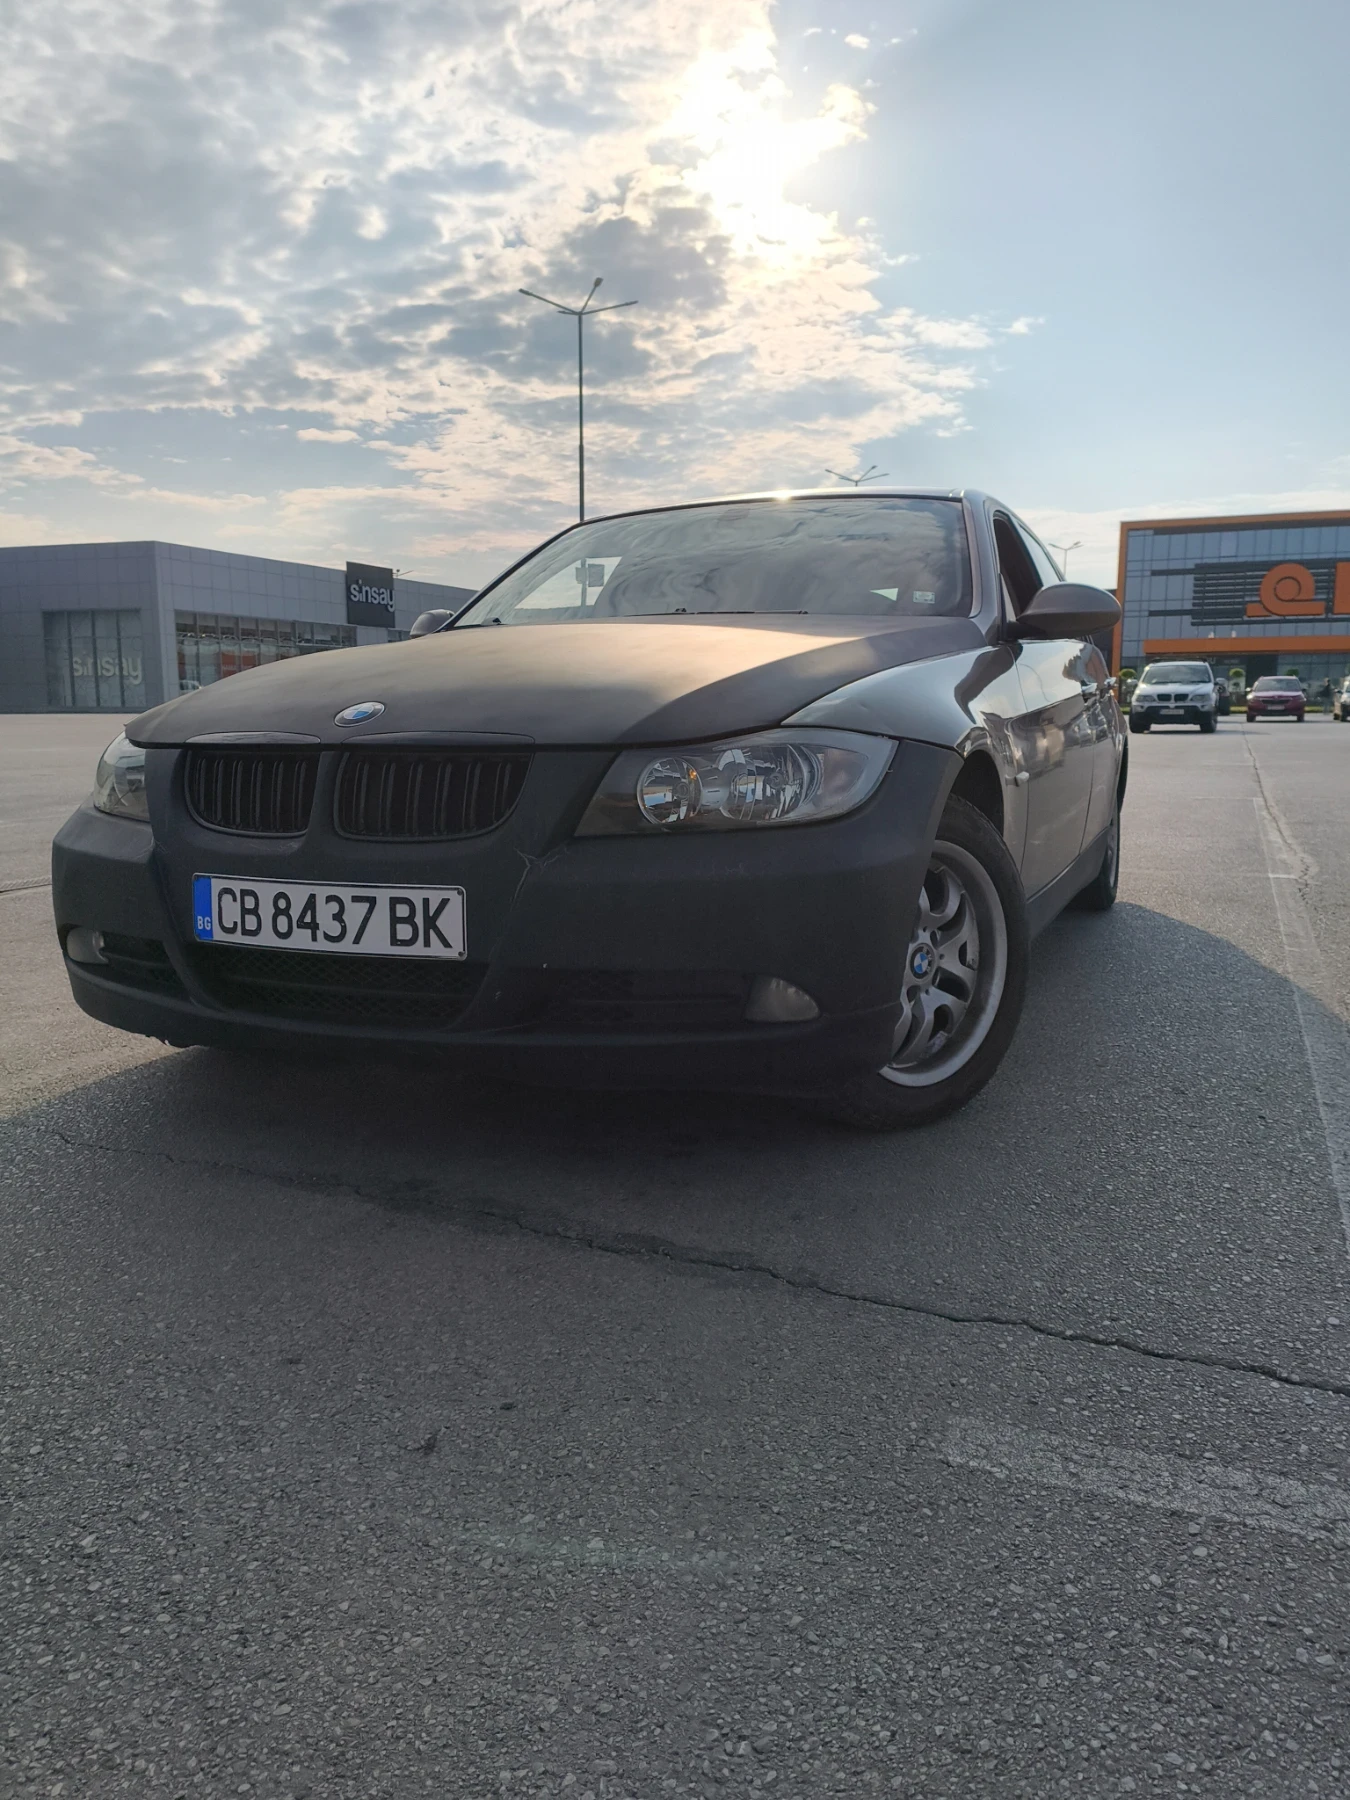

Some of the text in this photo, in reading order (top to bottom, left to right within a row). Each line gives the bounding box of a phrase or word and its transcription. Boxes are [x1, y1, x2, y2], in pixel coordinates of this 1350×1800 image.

[350, 579, 395, 612] sinsay
[197, 916, 211, 930] BG
[217, 887, 453, 949] CB 8437 BK
